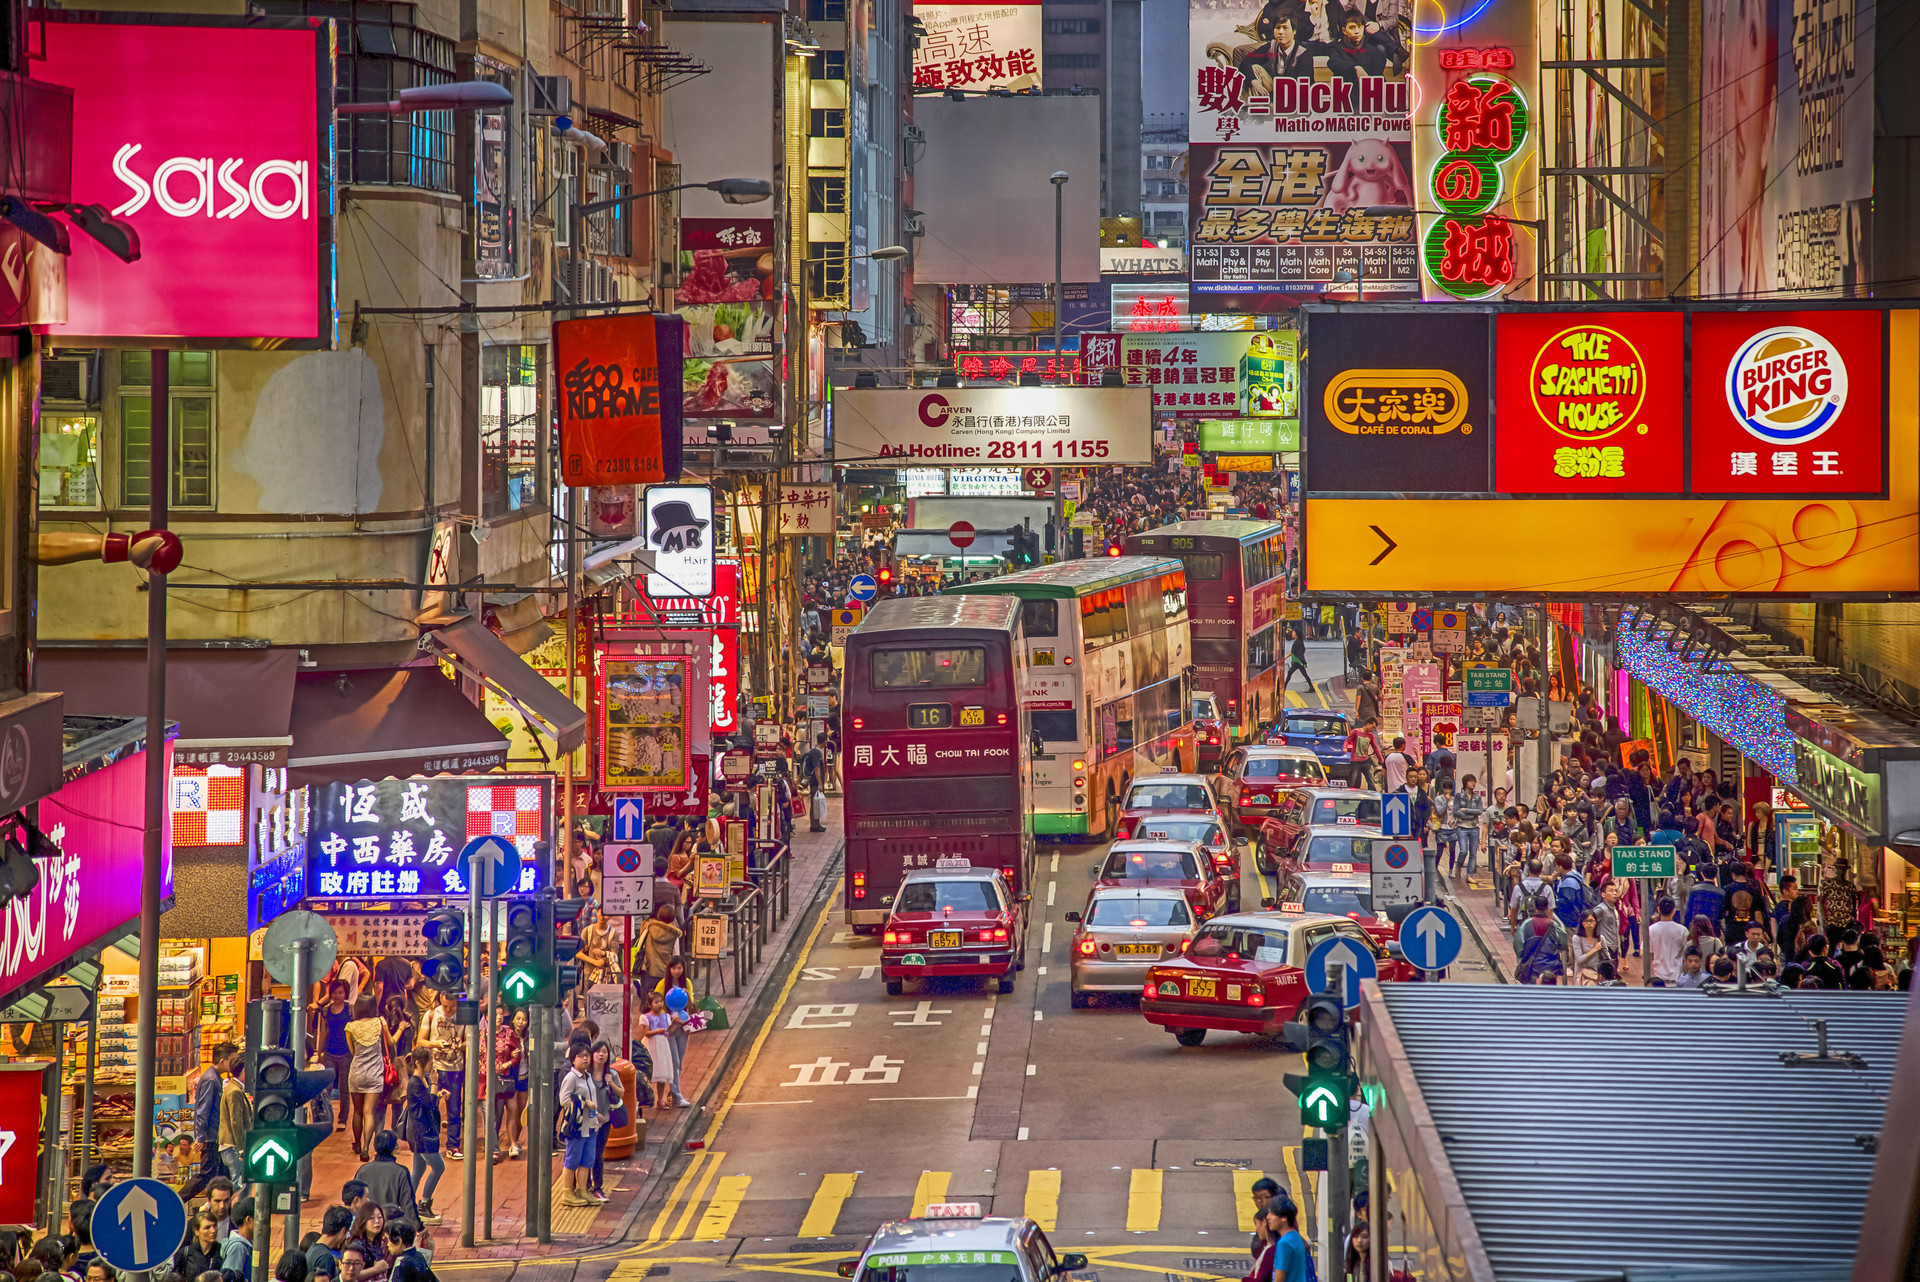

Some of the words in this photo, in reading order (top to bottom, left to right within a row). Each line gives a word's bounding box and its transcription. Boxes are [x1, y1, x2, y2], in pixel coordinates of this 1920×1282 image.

[1275, 79, 1354, 113] Dick
[1362, 78, 1410, 113] Hu
[112, 142, 309, 220] Sasa
[1204, 148, 1328, 207] 全港
[1230, 249, 1239, 257] S3
[1256, 249, 1271, 257] S45
[1286, 249, 1296, 257] S4
[1314, 249, 1324, 257] S5
[1342, 249, 1352, 257] S6
[1111, 257, 1178, 271] WHAT'S
[1196, 258, 1218, 266] Math
[1255, 258, 1271, 268] Phy
[1280, 258, 1302, 266] Math
[1308, 258, 1331, 266] Math
[1336, 258, 1358, 266] Math
[1364, 258, 1387, 266] Math
[1392, 257, 1415, 265] Math
[1222, 266, 1248, 274] chem
[1281, 266, 1302, 274] Core
[1309, 266, 1329, 274] Core
[1397, 266, 1410, 274] M2
[1561, 332, 1611, 362] THE
[1127, 346, 1198, 366] 連續4年
[1743, 349, 1829, 389] BURGER
[633, 367, 659, 383] CAFE
[1127, 367, 1235, 384] 全港銷量冠軍
[1745, 368, 1834, 421] KING
[1557, 399, 1624, 433] HOUSE
[975, 428, 994, 436] (Hong
[995, 428, 1014, 436] Kong)
[1016, 428, 1043, 436] Company
[1360, 424, 1384, 435] CAFÉ
[1386, 425, 1400, 435] DE
[1401, 425, 1432, 435] CORAL
[910, 443, 980, 458] Hotline:
[987, 440, 1043, 459] 2811
[1052, 440, 1109, 458] 1155
[607, 459, 631, 472] 2380
[634, 457, 658, 471] 8184
[1553, 446, 1625, 478] 意粉屋
[1730, 451, 1840, 476] 漢堡王
[663, 528, 702, 551] MR
[1172, 537, 1193, 549] 905
[684, 556, 708, 565] Hair
[1453, 644, 1464, 652] 12
[1474, 680, 1503, 688] 的士站
[920, 709, 940, 725] 16
[227, 751, 276, 762] 29443589
[853, 744, 928, 767] 周大福
[935, 750, 962, 758] CHOW
[965, 749, 980, 757] TAI
[984, 748, 1010, 757] FOOK
[462, 755, 500, 768] 29443589
[320, 829, 454, 867] 中西藥房
[1616, 849, 1637, 858] TAXI
[1639, 849, 1672, 858] STAND
[939, 859, 968, 867] TAXI
[1626, 861, 1663, 873] 的士站
[635, 881, 644, 892] 7
[1404, 877, 1413, 888] 7
[613, 886, 625, 894] 上午
[635, 899, 649, 910] 12
[1283, 902, 1300, 910] TAXI
[701, 926, 716, 934] 12B
[1119, 946, 1131, 954] RD
[1134, 945, 1158, 953] 2382
[1193, 987, 1212, 996] 577
[783, 1000, 952, 1030] 巴士
[930, 1205, 976, 1217] TAXI
[878, 1256, 908, 1266] POAD
